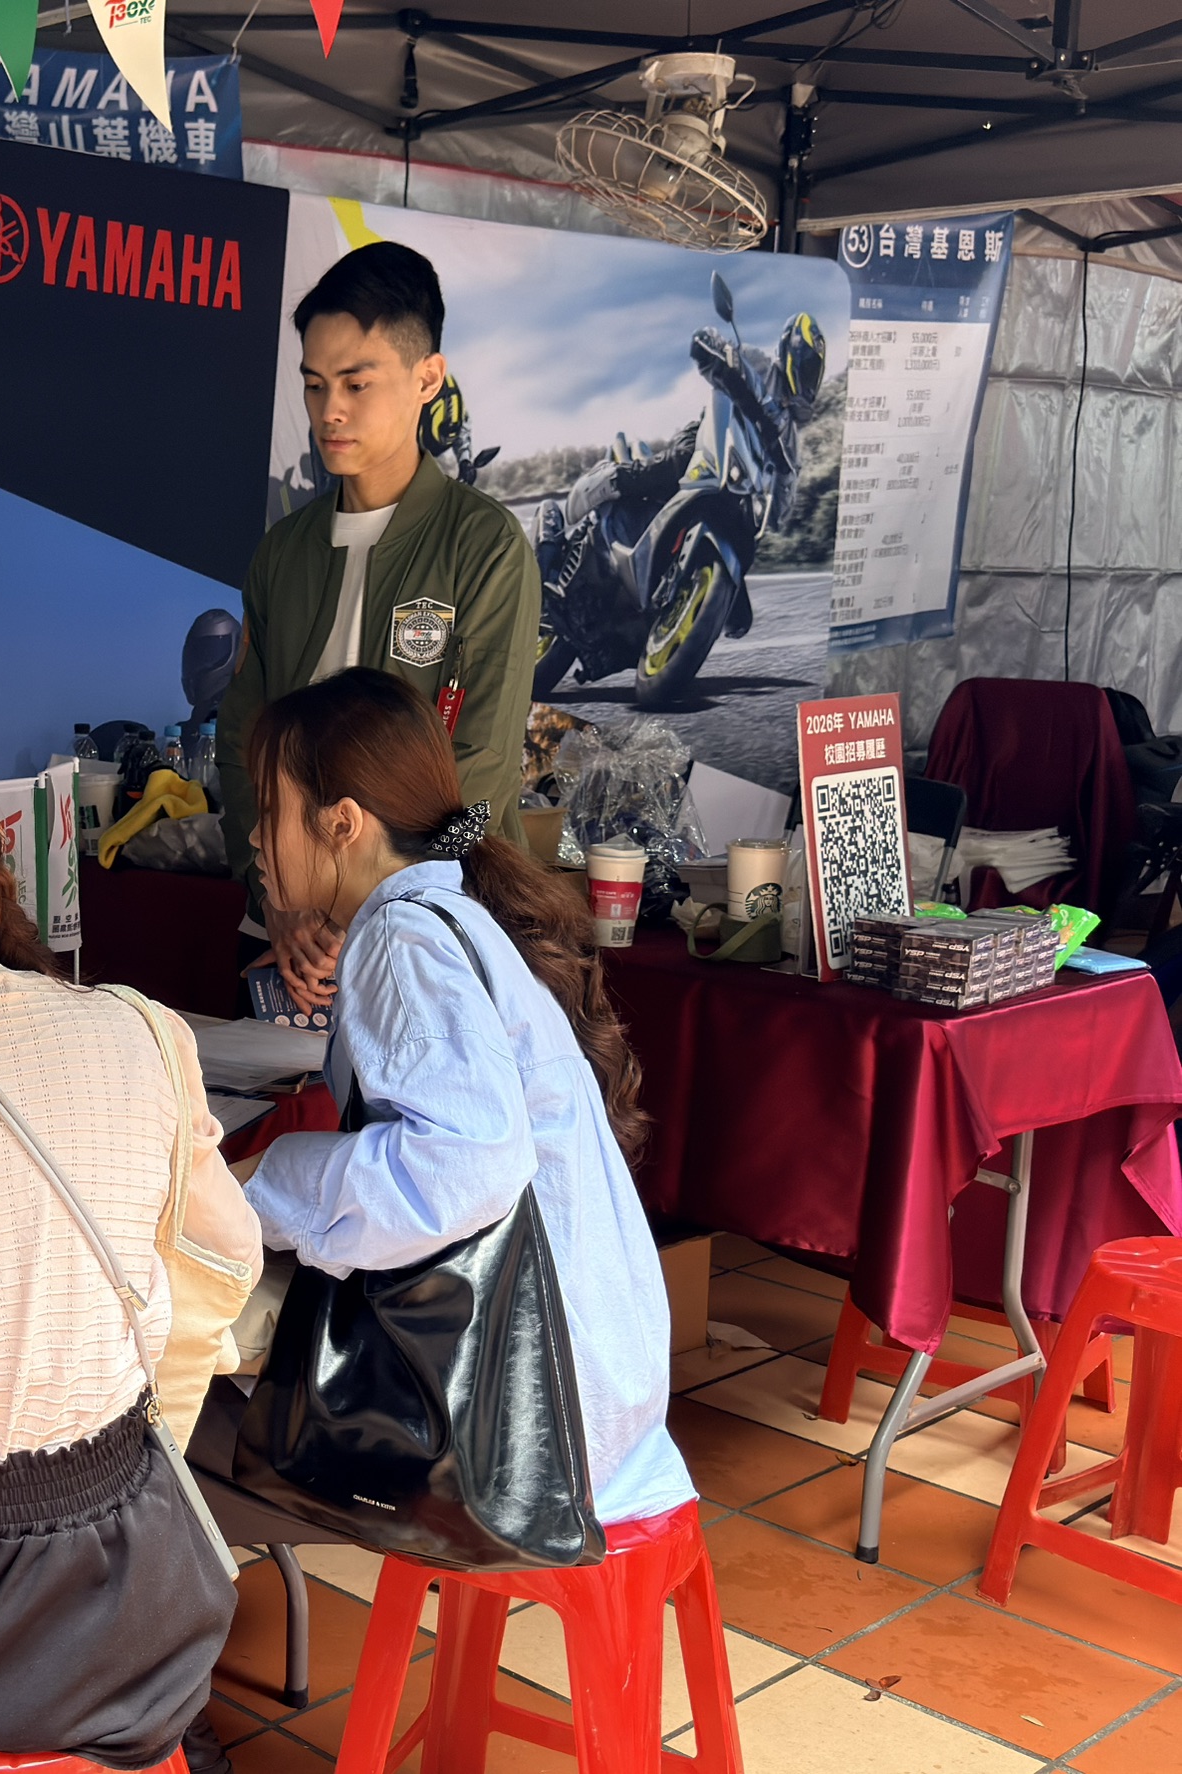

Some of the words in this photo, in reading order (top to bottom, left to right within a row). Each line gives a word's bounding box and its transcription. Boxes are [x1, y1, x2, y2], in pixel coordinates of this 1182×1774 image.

[140, 16, 152, 24] TEC
[847, 225, 868, 253] 53
[879, 223, 1005, 262] 台灣基恩斯
[36, 207, 242, 310] YAMAHA
[806, 712, 844, 734] 2026年
[848, 708, 894, 729] YAMAHA
[824, 738, 886, 766] 校園招募履歷
[853, 934, 871, 942] YSP
[854, 947, 873, 955] YSP
[904, 948, 925, 956] YSP
[854, 960, 873, 968] YSP
[847, 973, 865, 981] YSP
